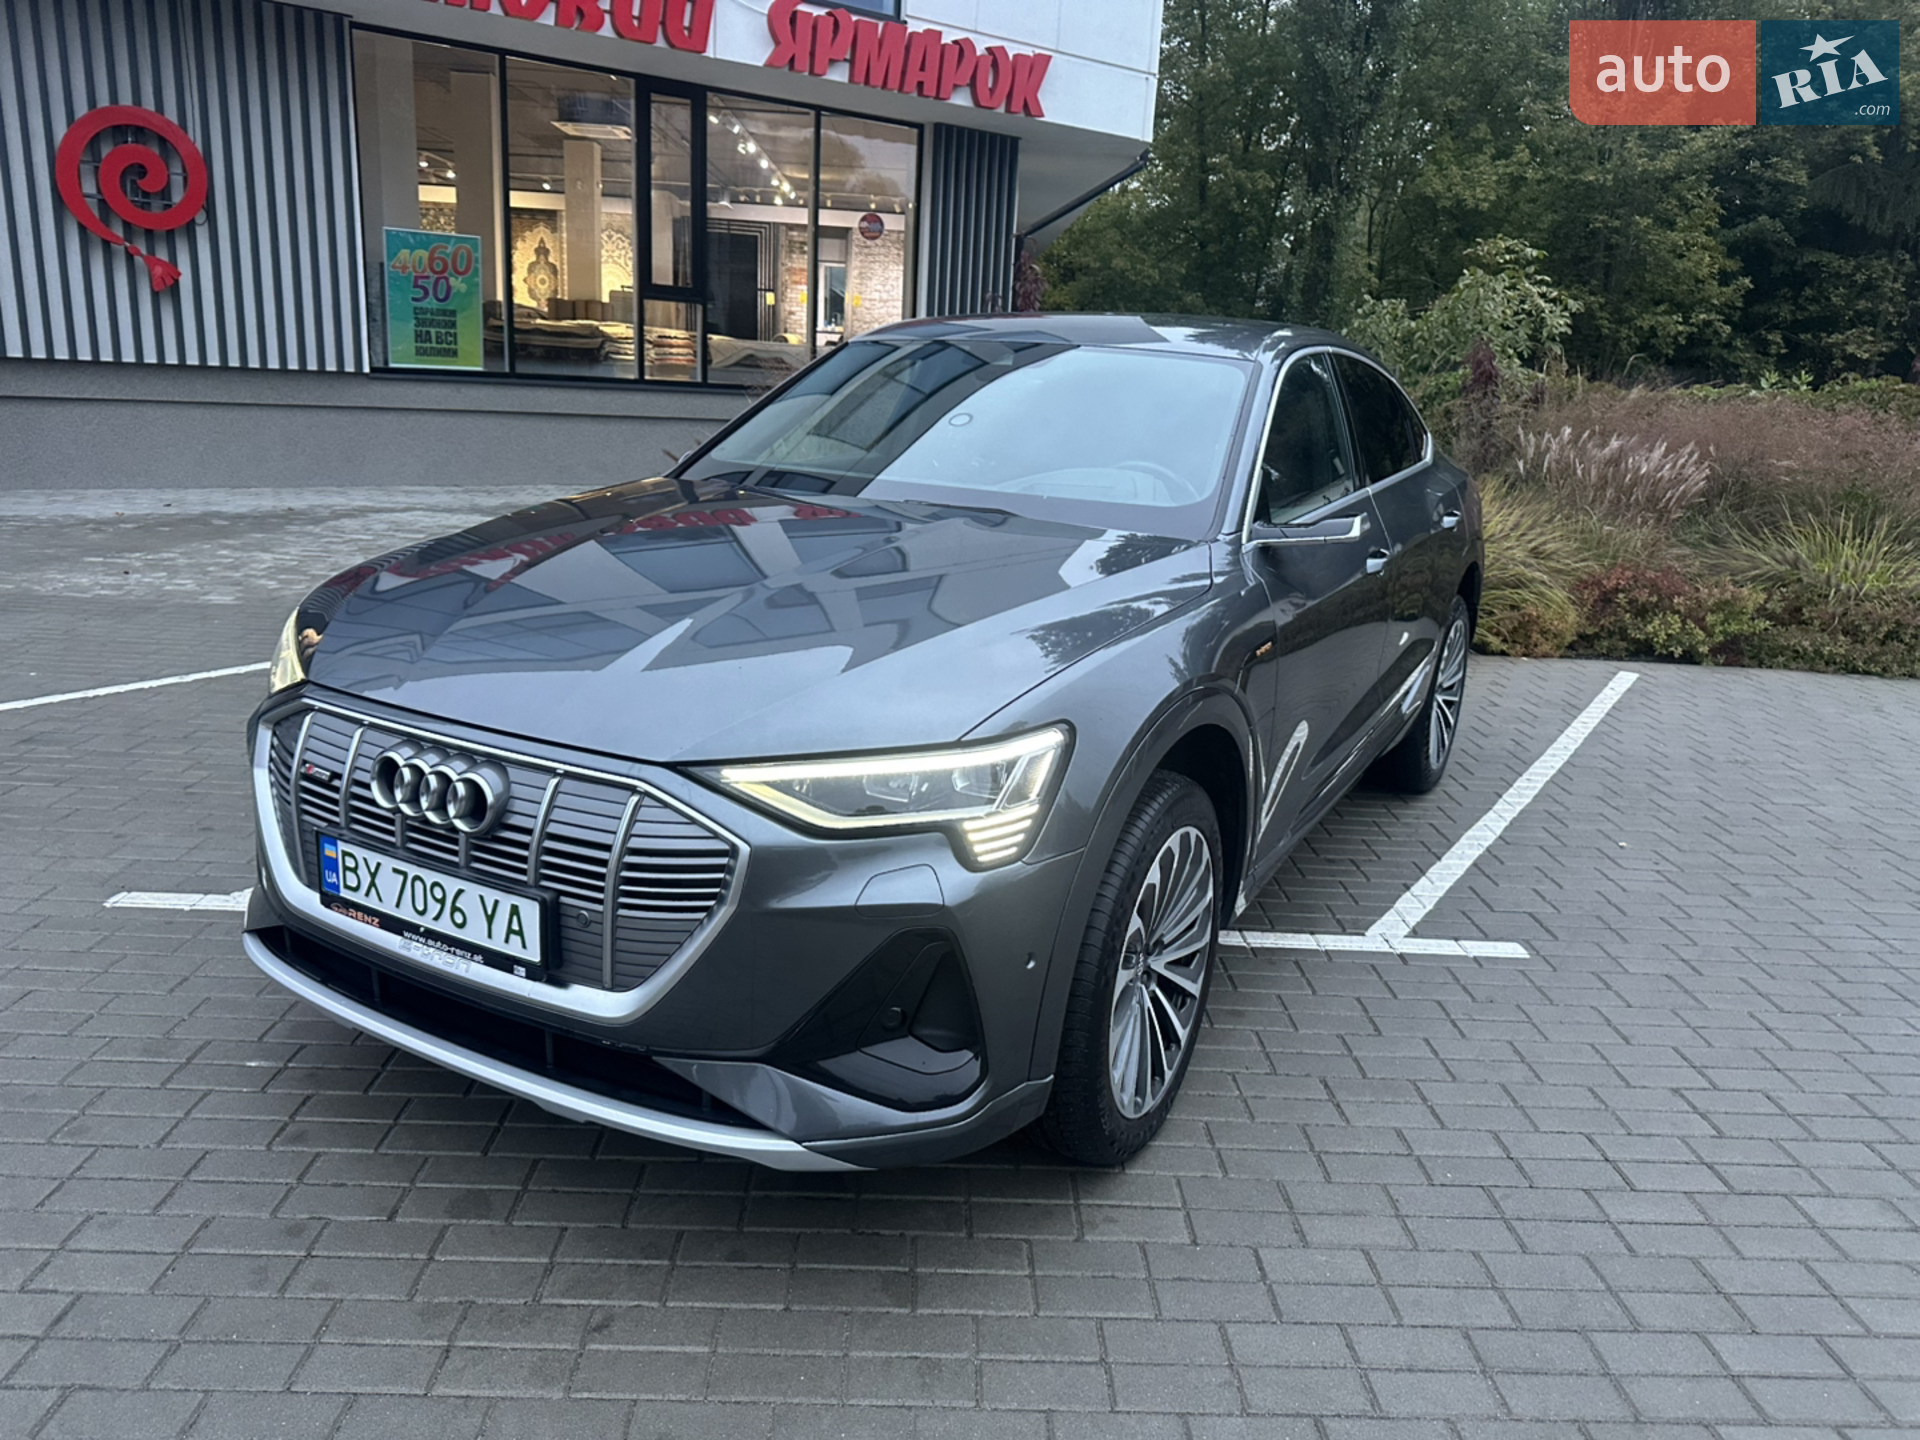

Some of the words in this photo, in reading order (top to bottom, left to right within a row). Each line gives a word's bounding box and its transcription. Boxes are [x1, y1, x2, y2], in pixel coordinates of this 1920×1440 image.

[762, 0, 1052, 118] ЯРМАРОК
[391, 248, 429, 276] 40
[427, 242, 474, 277] 60
[414, 329, 433, 345] НА
[435, 330, 458, 347] ВСІ
[325, 869, 338, 886] UA
[340, 849, 383, 903] BX
[391, 867, 468, 930] 7096
[479, 893, 528, 950] YA
[402, 929, 485, 964] www.auto-renz.at
